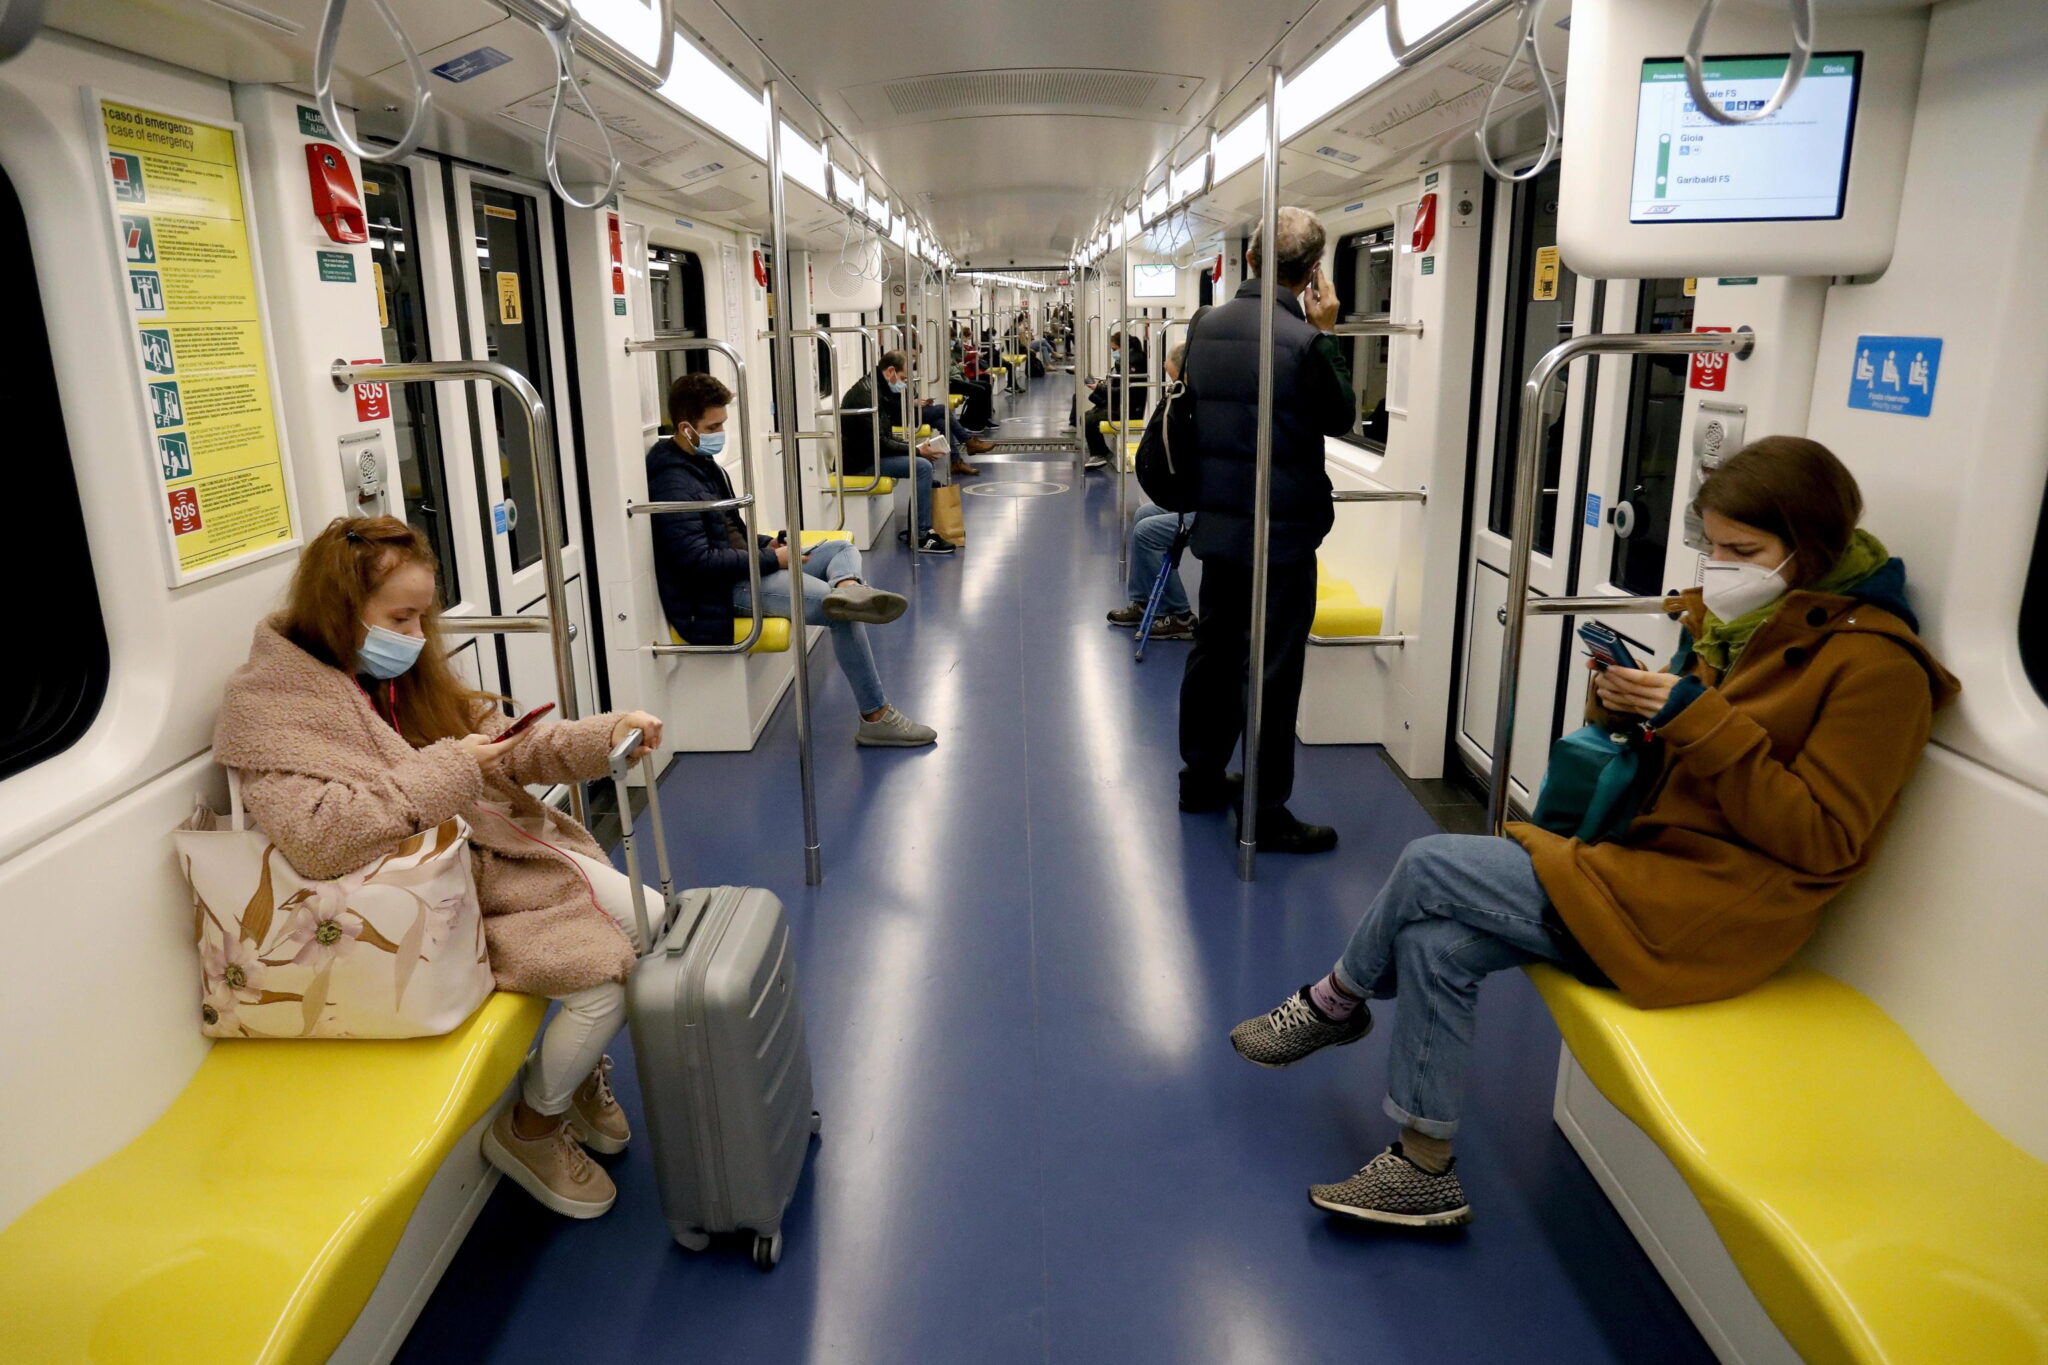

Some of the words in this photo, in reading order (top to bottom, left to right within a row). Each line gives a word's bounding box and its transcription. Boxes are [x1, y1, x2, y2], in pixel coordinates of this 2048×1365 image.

[1822, 65, 1846, 74] Gioia
[1684, 89, 1724, 99] Crale
[1725, 89, 1738, 98] FS
[108, 109, 133, 122] caso
[134, 113, 144, 126] di
[144, 117, 194, 136] emergenza
[305, 111, 322, 123] ALLAR
[111, 124, 134, 139] case
[135, 129, 145, 140] of
[146, 132, 194, 153] emergency
[1680, 134, 1704, 142] Gioia
[1676, 175, 1717, 184] Garibaldi
[1718, 175, 1731, 183] FS
[1696, 351, 1724, 369] SOS
[358, 383, 383, 400] SOS
[173, 503, 196, 520] SOS
